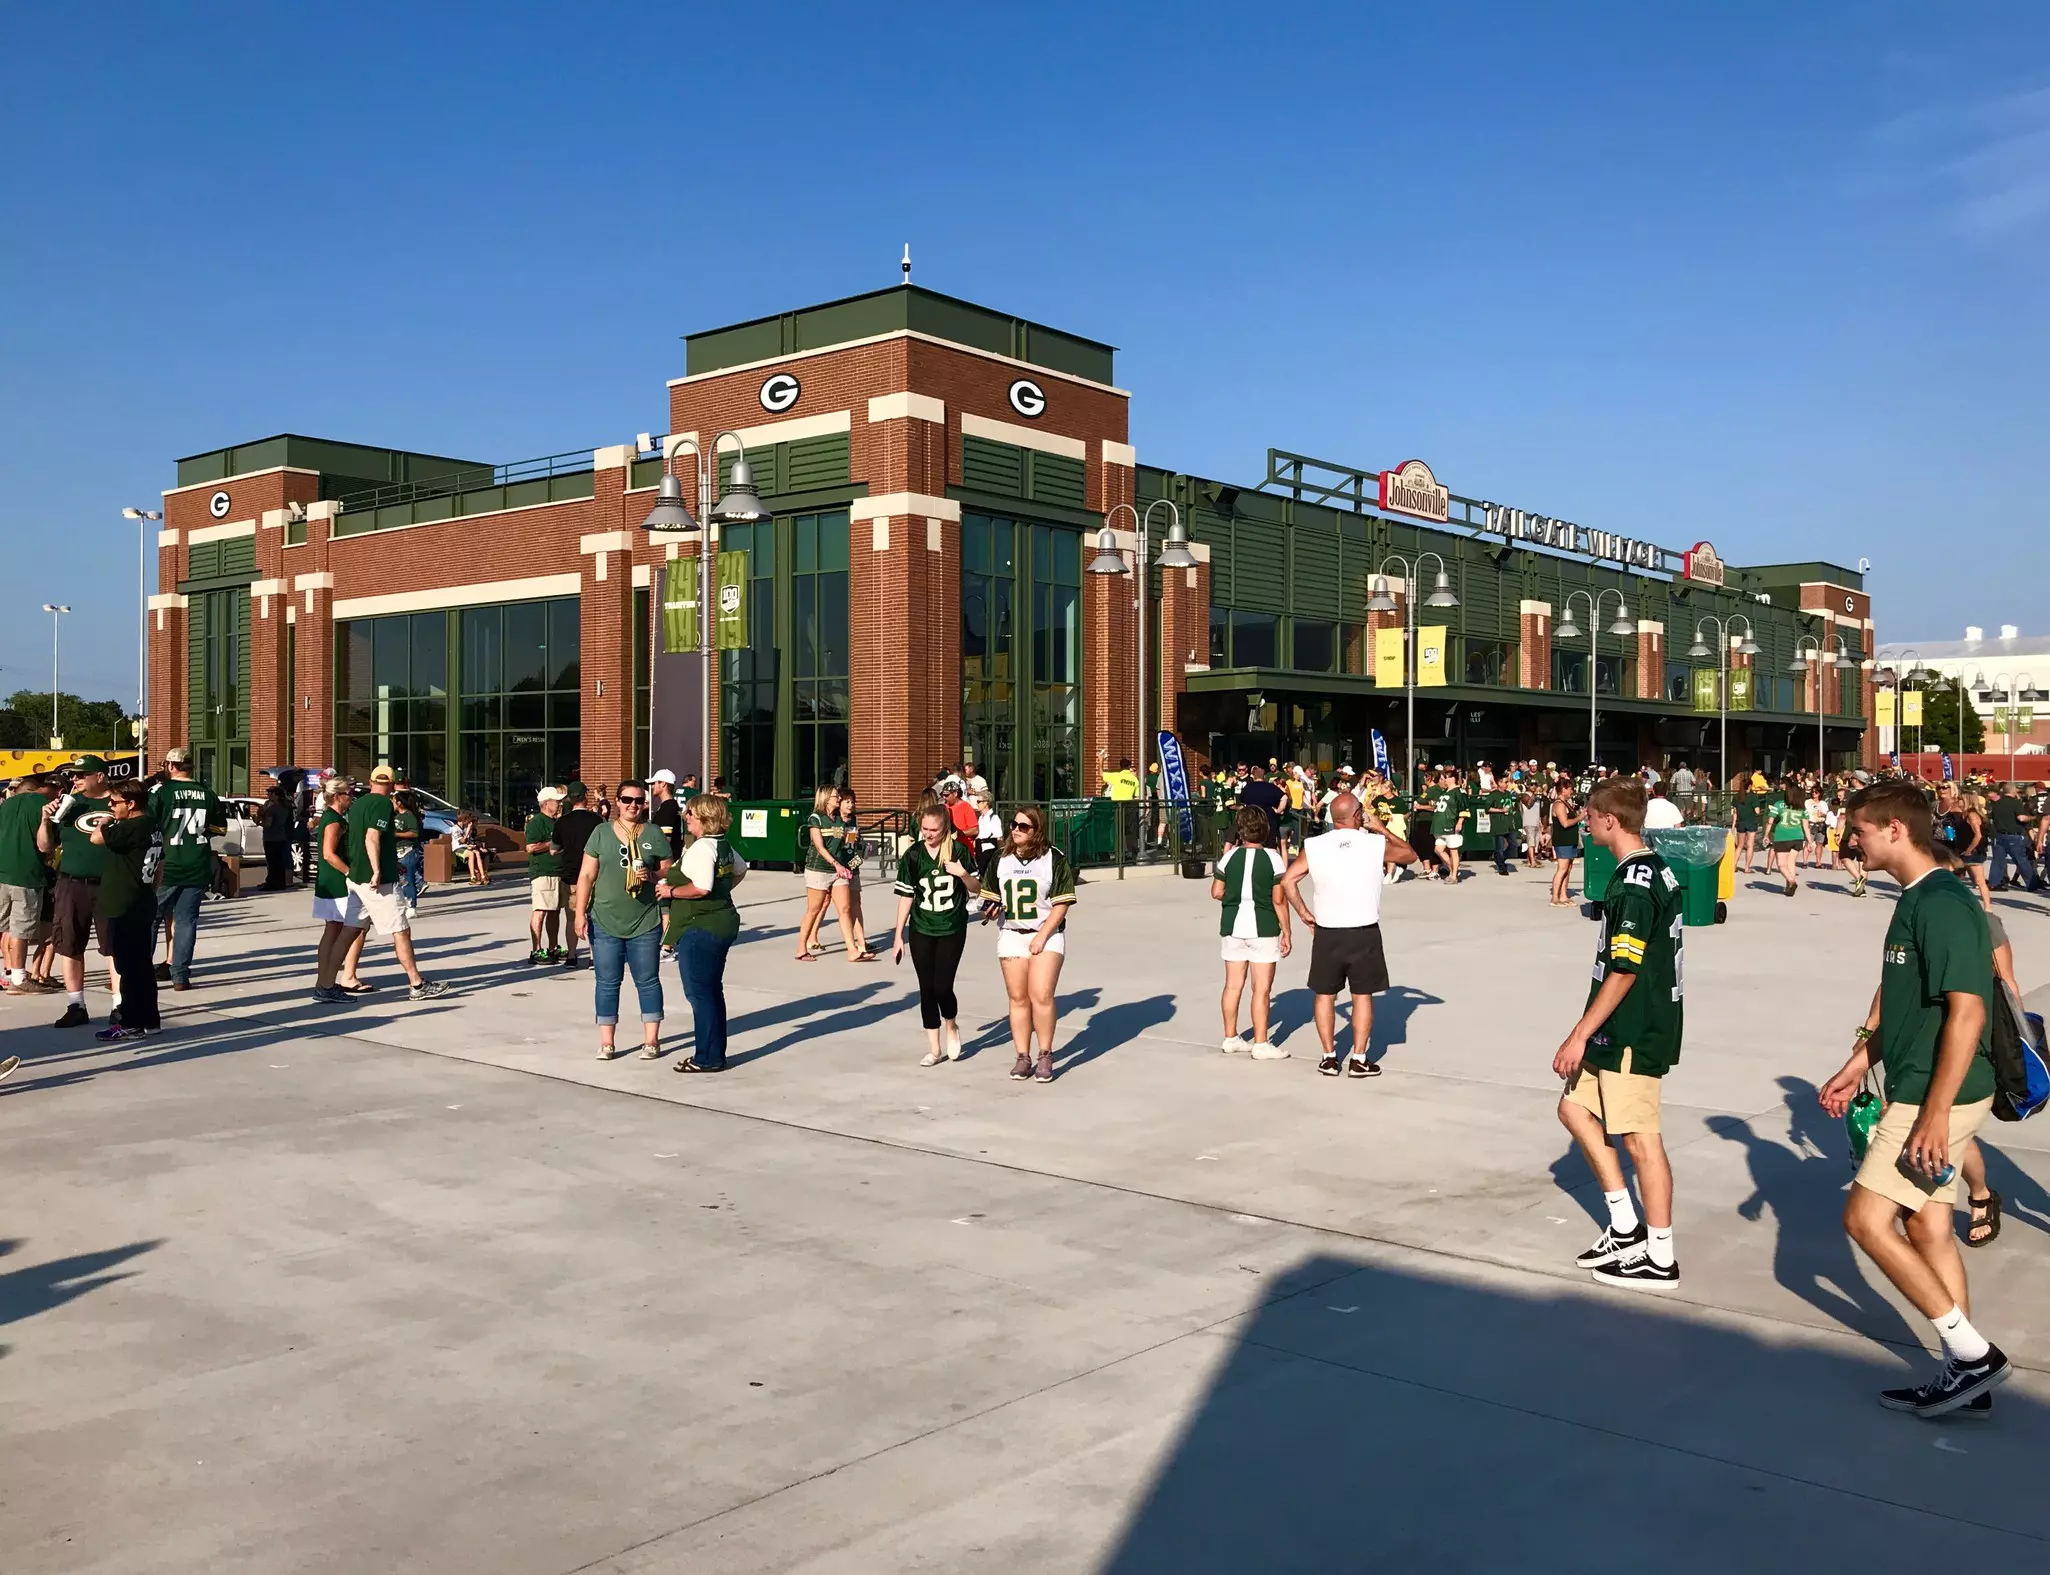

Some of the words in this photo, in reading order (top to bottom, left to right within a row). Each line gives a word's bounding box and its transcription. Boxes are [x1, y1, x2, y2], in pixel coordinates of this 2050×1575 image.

[759, 374, 799, 412] G
[1009, 379, 1046, 417] G
[210, 491, 231, 517] G
[1389, 477, 1446, 517] Johnsonville
[1483, 500, 1581, 550] TAILGATE
[1586, 527, 1662, 571] VILLAGE
[1691, 555, 1723, 582] Johnsonville
[1845, 596, 1854, 612] G
[1163, 736, 1185, 800] WIXX
[1580, 783, 1591, 793] 87
[170, 808, 208, 845] 74
[1781, 811, 1802, 826] 15
[919, 875, 954, 912] 12
[1624, 864, 1652, 889] 12
[1004, 878, 1038, 920] 12
